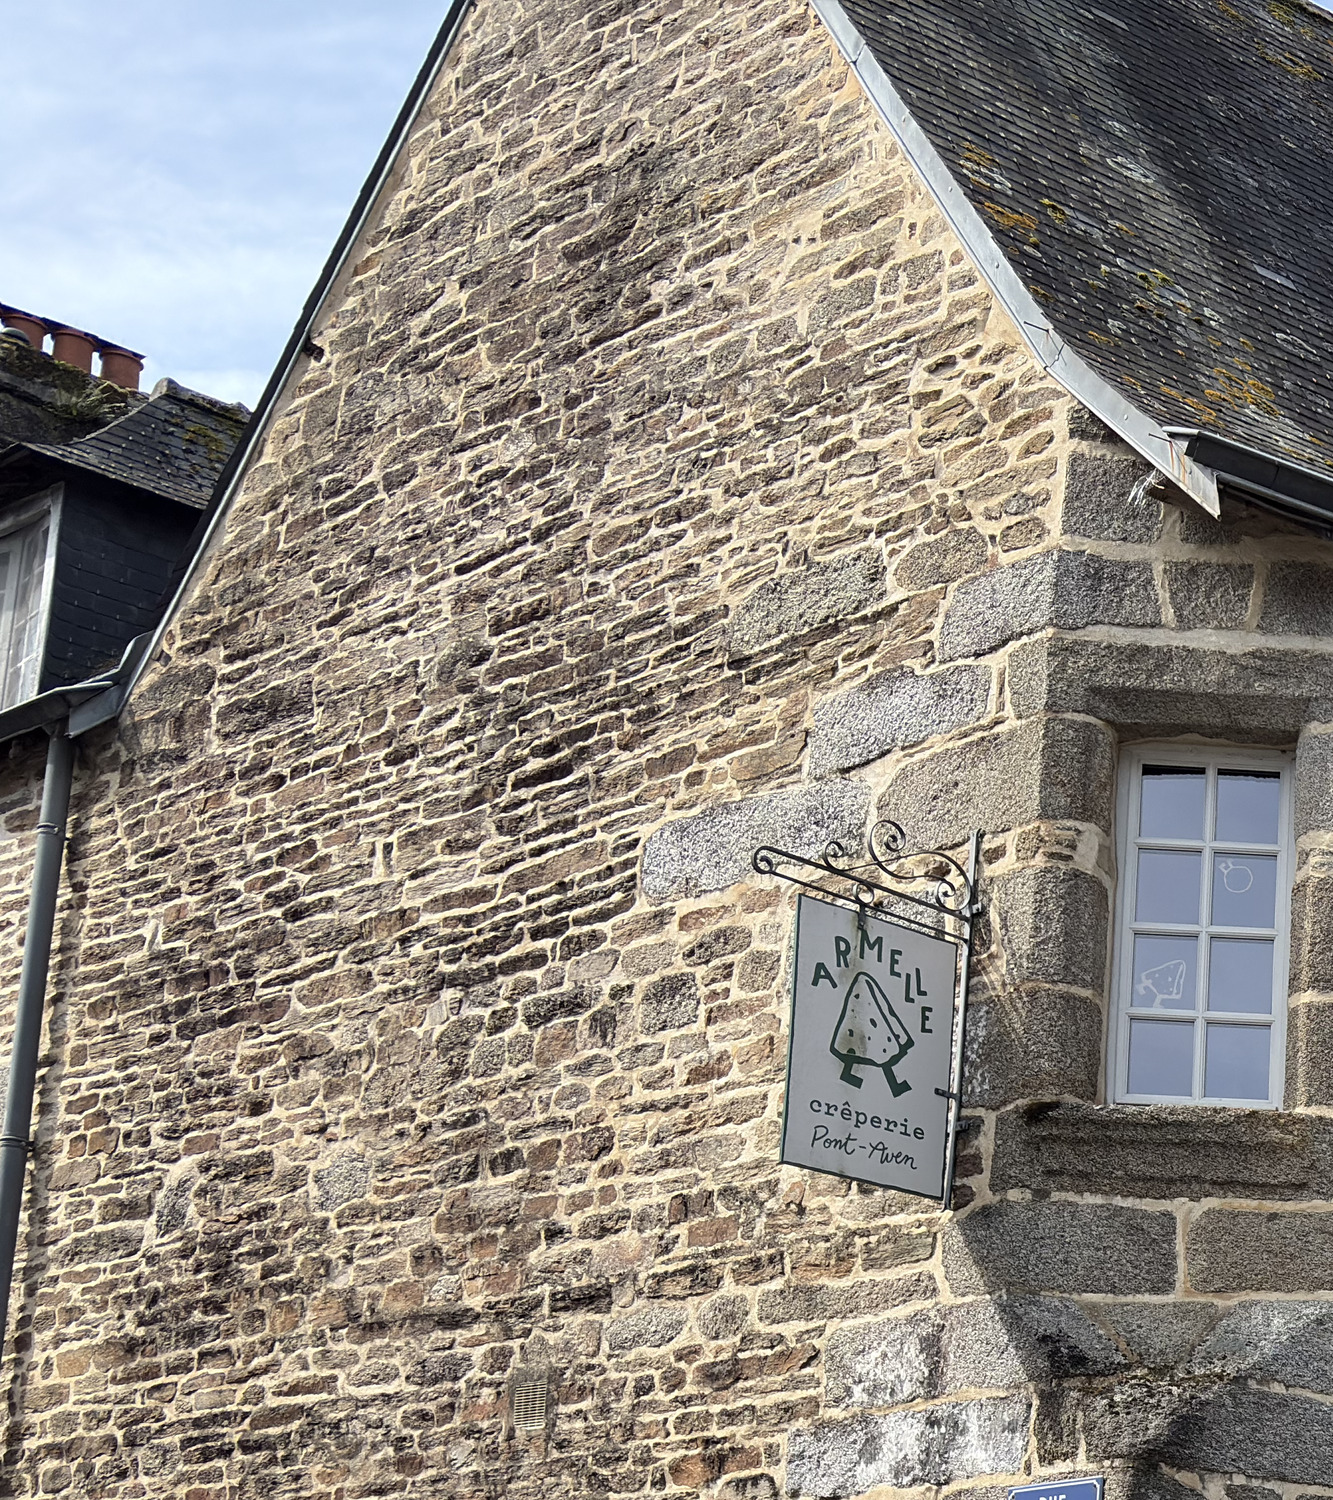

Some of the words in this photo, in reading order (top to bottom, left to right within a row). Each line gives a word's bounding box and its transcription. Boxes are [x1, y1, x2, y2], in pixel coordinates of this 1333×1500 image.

[811, 928, 933, 1034] ARMELLE
[809, 1099, 925, 1140] crêperie
[811, 1124, 918, 1170] Pont-Aven
